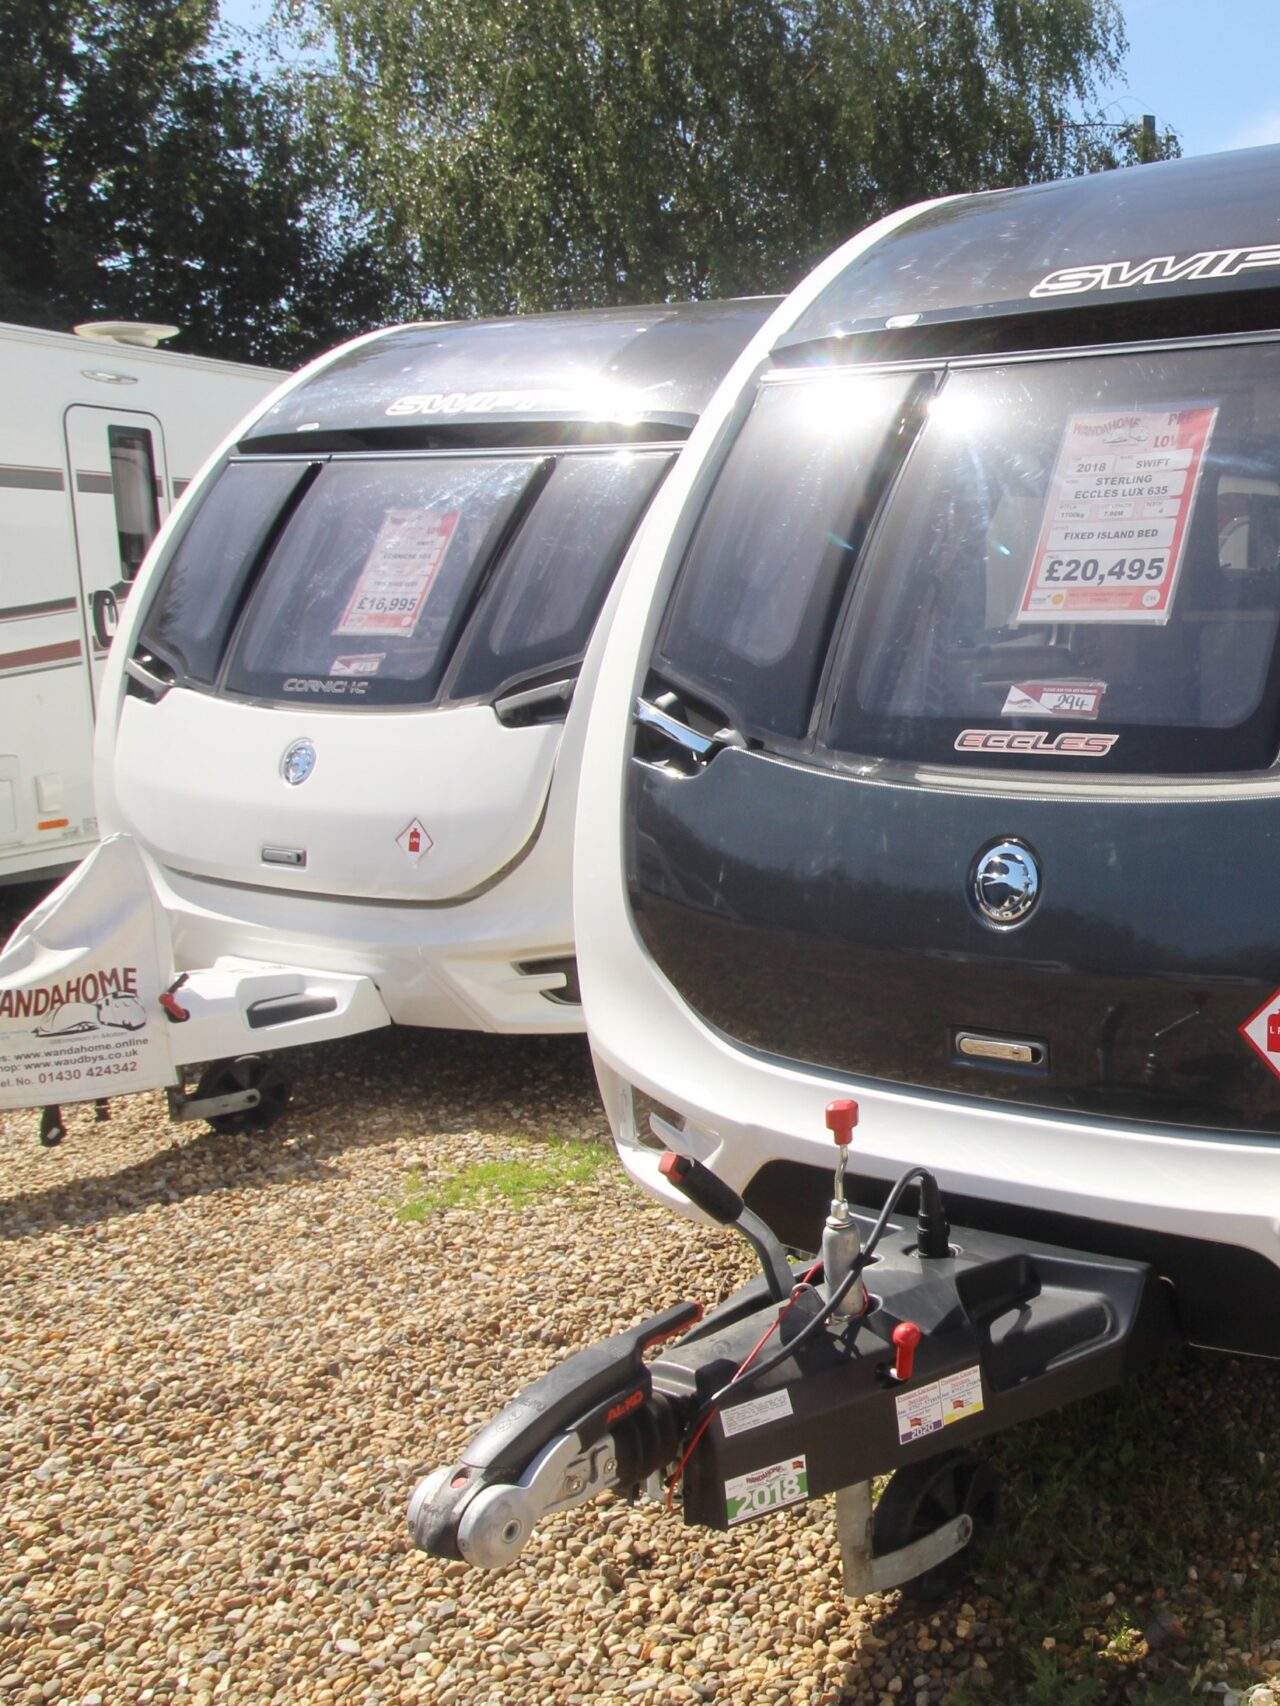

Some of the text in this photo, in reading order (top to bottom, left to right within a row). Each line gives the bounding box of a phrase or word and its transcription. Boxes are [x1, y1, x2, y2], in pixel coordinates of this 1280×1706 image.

[1168, 412, 1193, 426] PRE
[1076, 463, 1106, 473] 2018
[1136, 458, 1170, 469] SWIFT
[1095, 474, 1152, 486] STERLING
[1074, 486, 1168, 499] ECCLES LUX 635
[1064, 529, 1158, 540] FIXED ISLAND BED
[1045, 558, 1165, 586] £20,495
[357, 597, 417, 613] £16,995
[1052, 694, 1089, 711] 294
[954, 729, 1119, 757] ECCLES
[0, 968, 137, 1018] ANDAHOME
[14, 1038, 149, 1061] www.wandahome.online
[24, 1048, 138, 1071] www.waudbys.co.uk
[16, 1077, 34, 1086] No.
[38, 1069, 82, 1084] 01430
[86, 1061, 137, 1077] 424342
[607, 1390, 645, 1424] AL-KO
[911, 1423, 935, 1438] 2020
[736, 1474, 801, 1517] 2018
